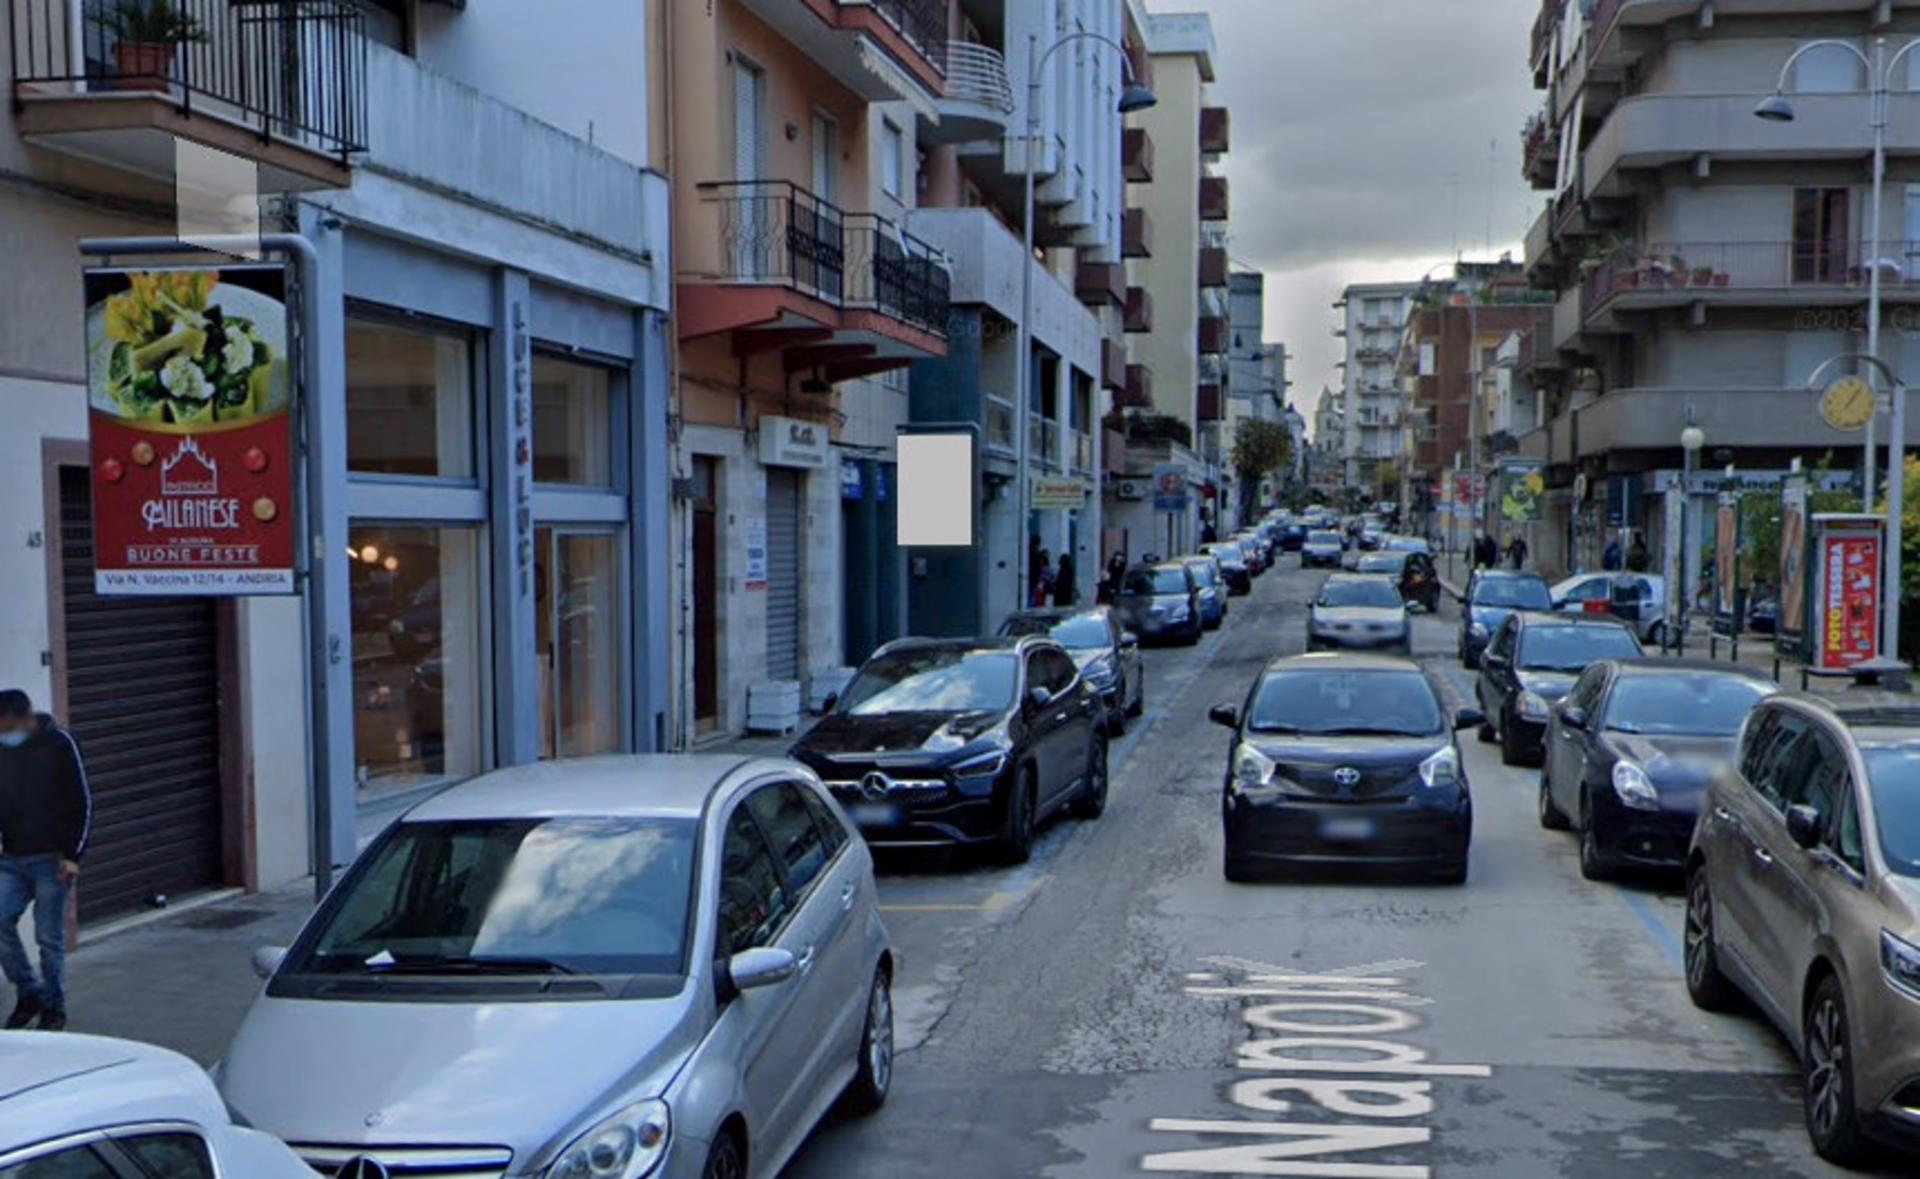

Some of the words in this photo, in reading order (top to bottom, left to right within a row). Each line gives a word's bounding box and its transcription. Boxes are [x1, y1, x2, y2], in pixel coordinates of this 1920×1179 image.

[142, 498, 240, 533] MILANESE
[127, 548, 192, 562] BUONE
[201, 548, 259, 562] FESTE
[104, 574, 126, 586] Via
[127, 574, 139, 586] N.
[144, 574, 191, 586] Vaccina
[193, 573, 225, 586] 12/14
[236, 573, 286, 586] ANDRIA
[1828, 543, 1843, 651] FOTOTESSERA
